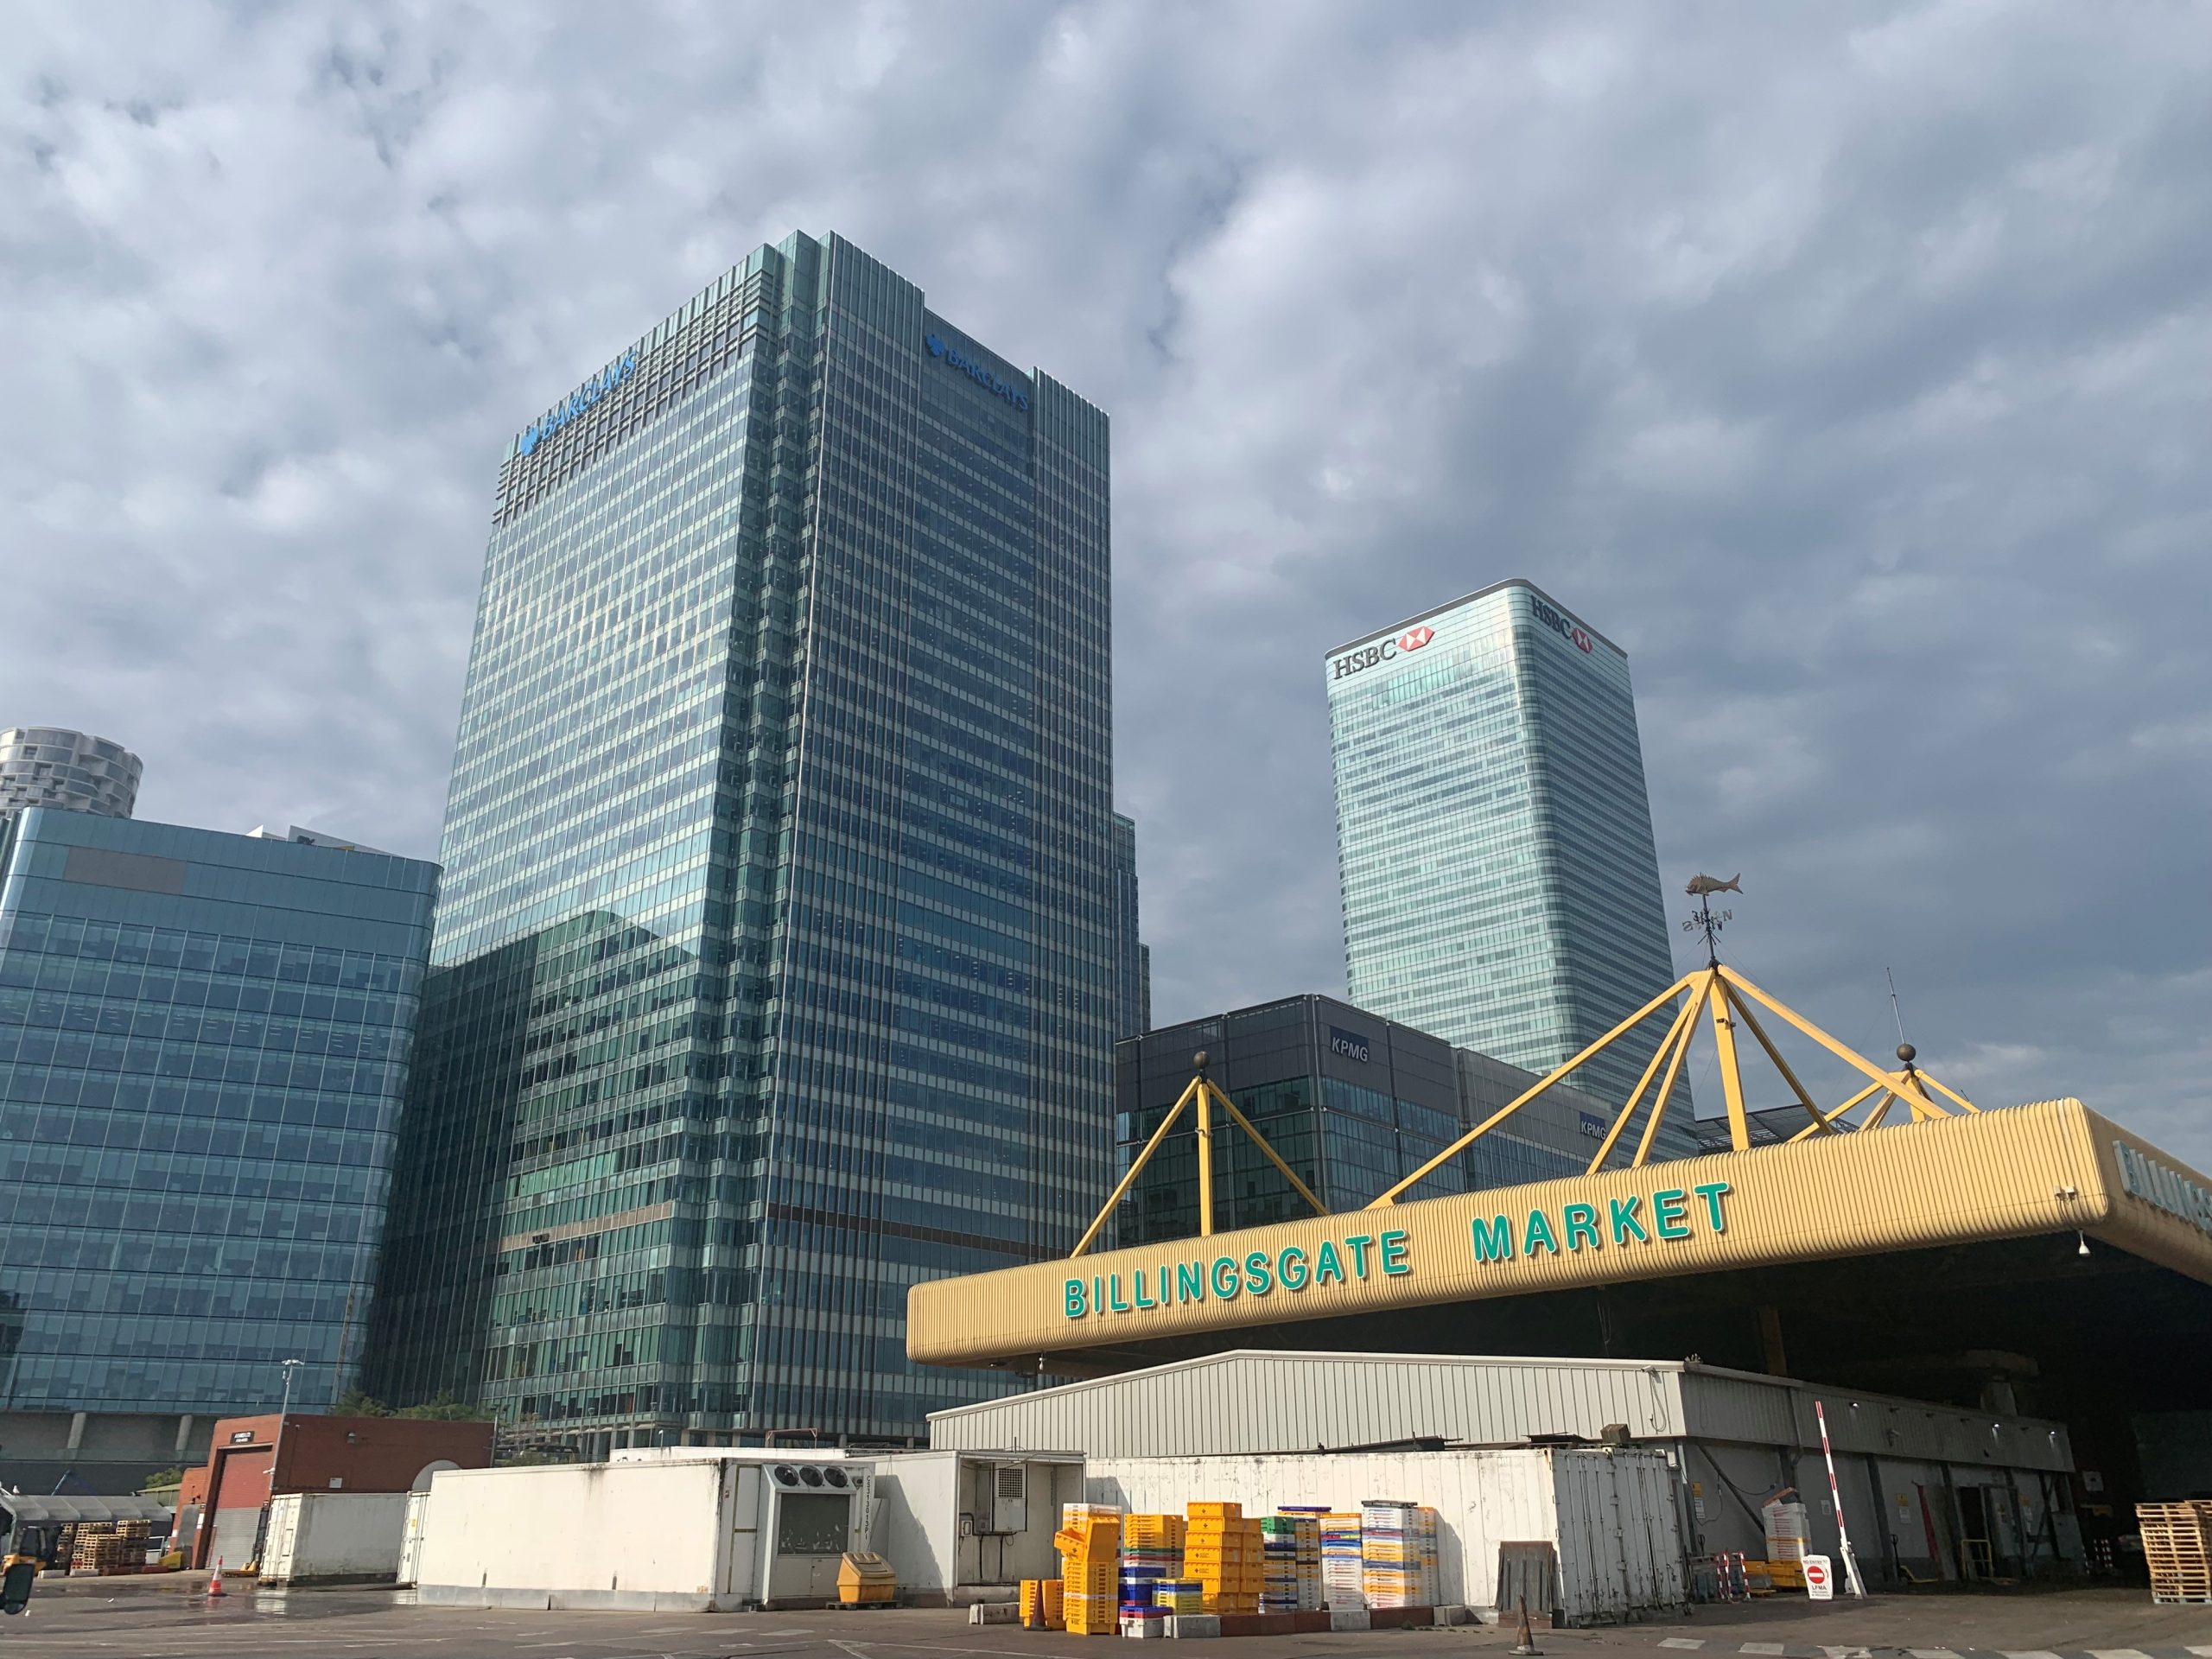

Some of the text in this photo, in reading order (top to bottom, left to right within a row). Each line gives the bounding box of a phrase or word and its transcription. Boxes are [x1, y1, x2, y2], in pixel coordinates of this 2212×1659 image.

[542, 351, 638, 442] BARCLAYS
[946, 349, 1028, 412] BARCLAYS
[1530, 594, 1572, 640] HSBC
[1333, 637, 1398, 680] HSBC
[1332, 1036, 1369, 1063] KPMG
[1580, 1120, 1606, 1141] KPMG
[1064, 1181, 1731, 1319] BILLINGSGATE MARKET
